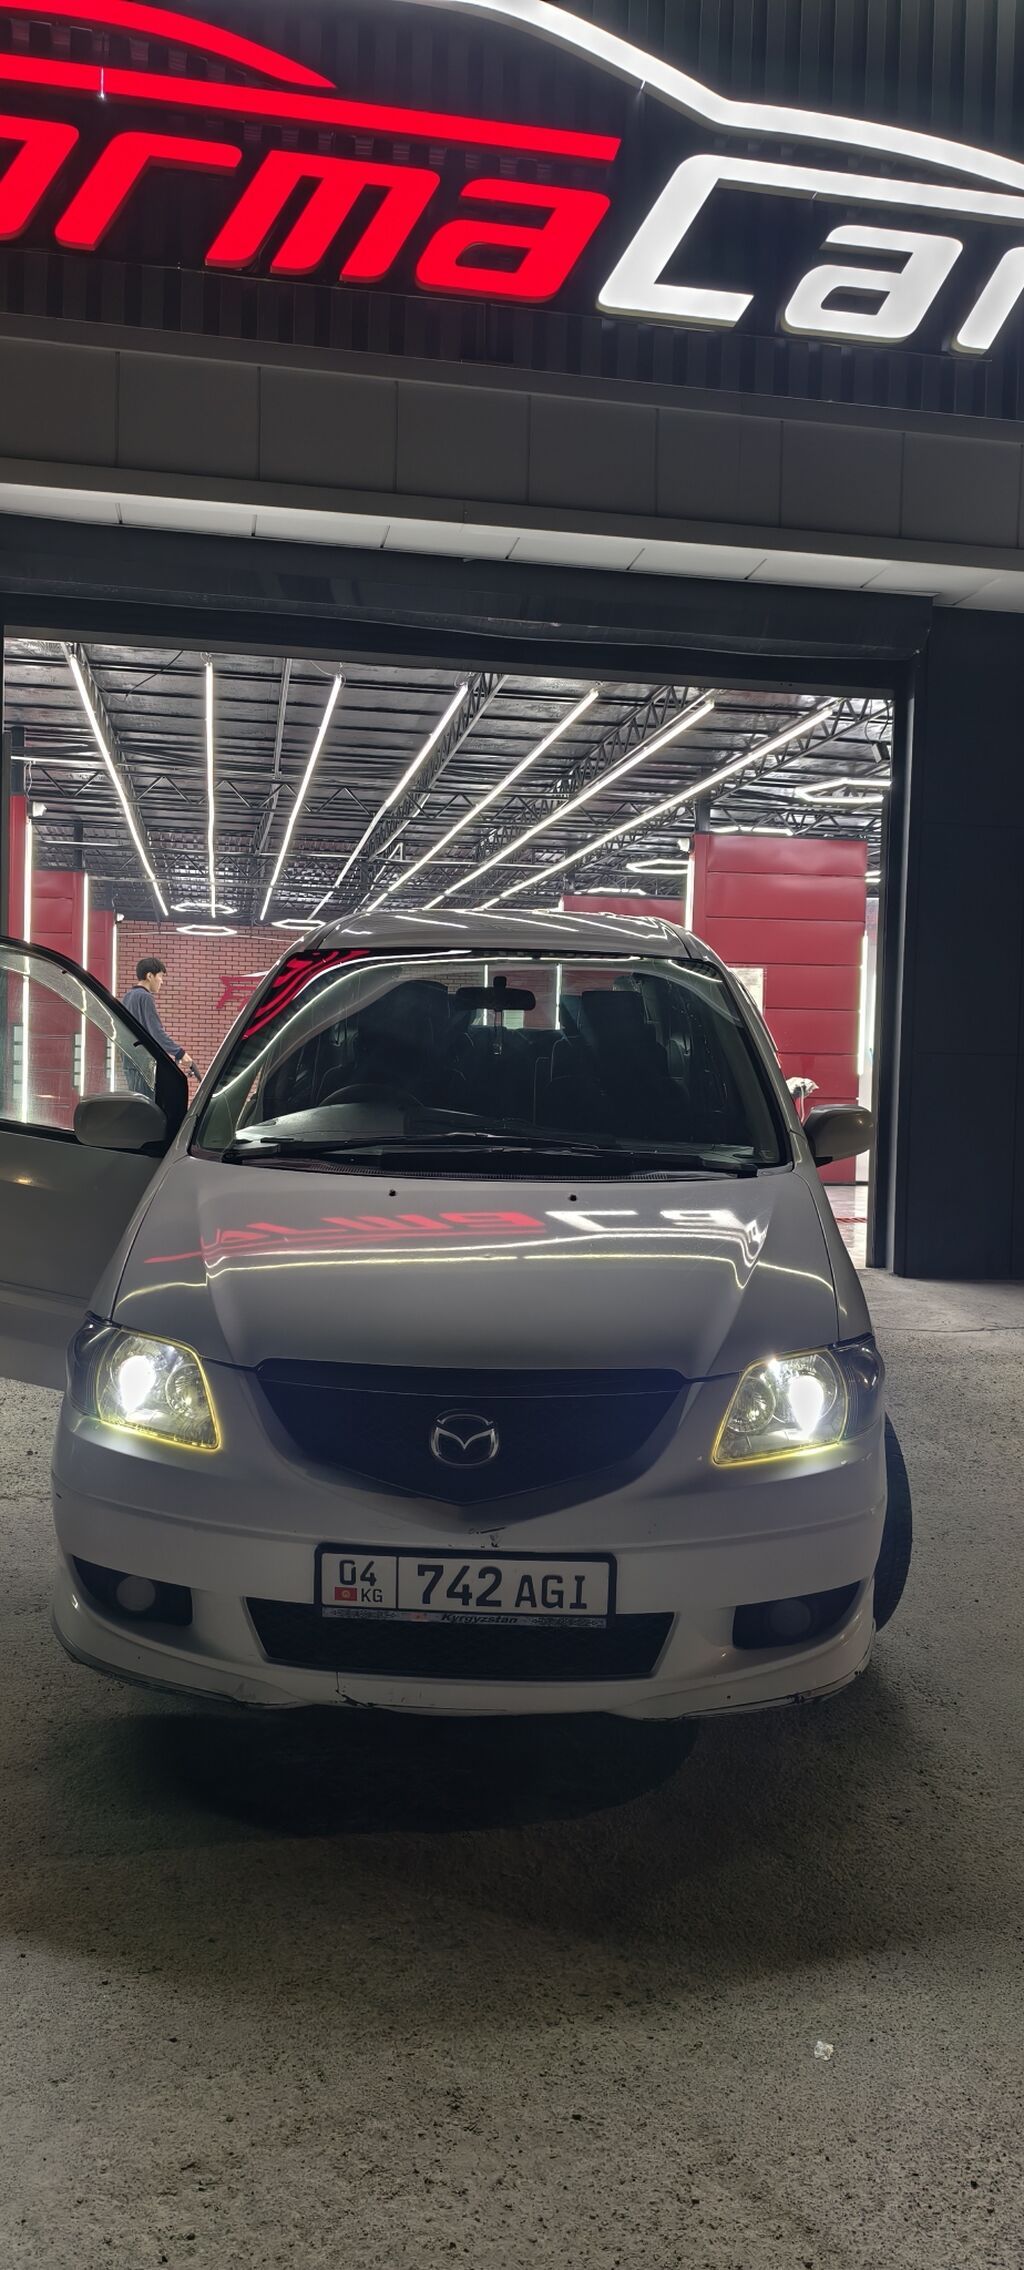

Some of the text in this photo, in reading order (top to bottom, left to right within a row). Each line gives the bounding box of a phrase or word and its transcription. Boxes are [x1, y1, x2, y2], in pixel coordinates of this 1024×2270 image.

[339, 1560, 377, 1586] 04
[361, 1588, 383, 1602] KG
[417, 1564, 588, 1609] 742 AGI
[441, 1613, 518, 1624] Kyrgyzstan
